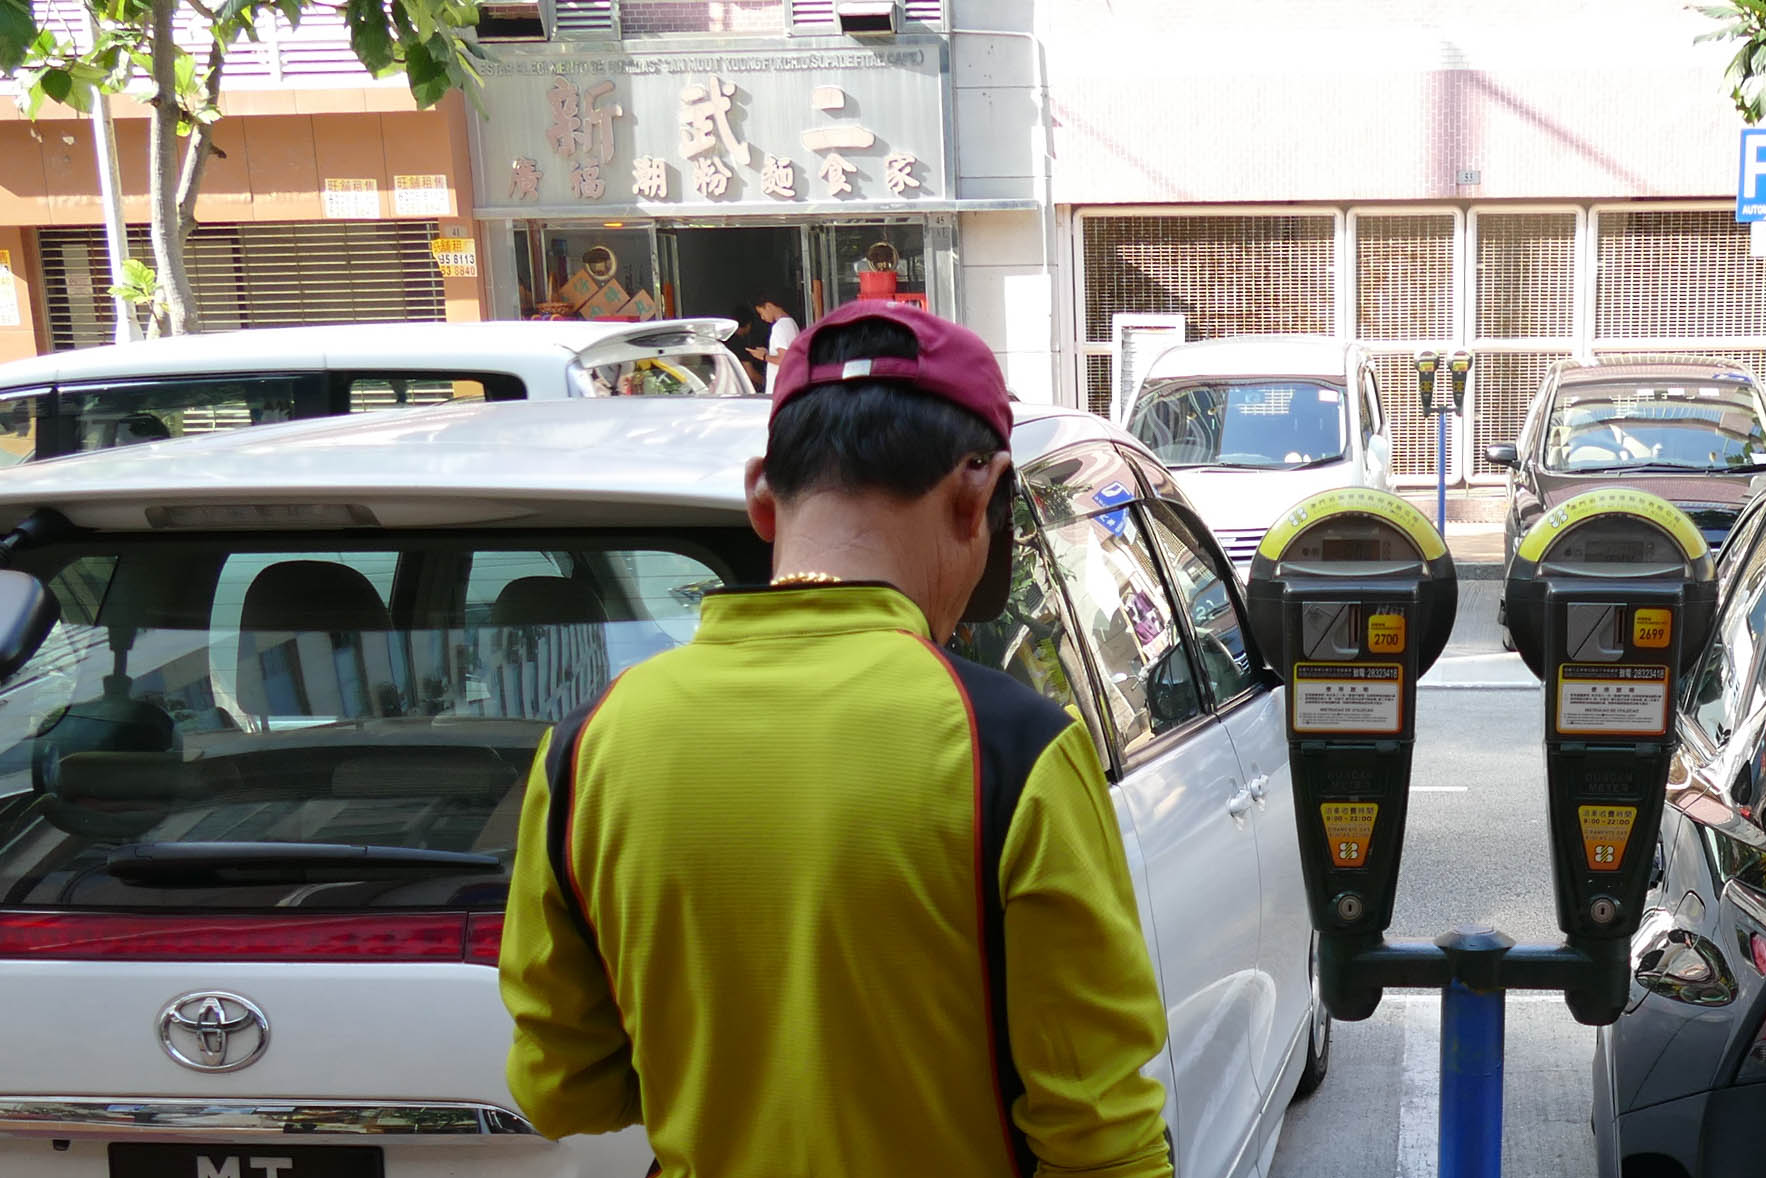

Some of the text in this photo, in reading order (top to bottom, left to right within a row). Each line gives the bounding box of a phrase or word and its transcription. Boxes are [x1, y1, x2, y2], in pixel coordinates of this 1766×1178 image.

[545, 73, 877, 164] 新武二
[1374, 633, 1399, 646] 2700
[1639, 628, 1665, 640] 2699
